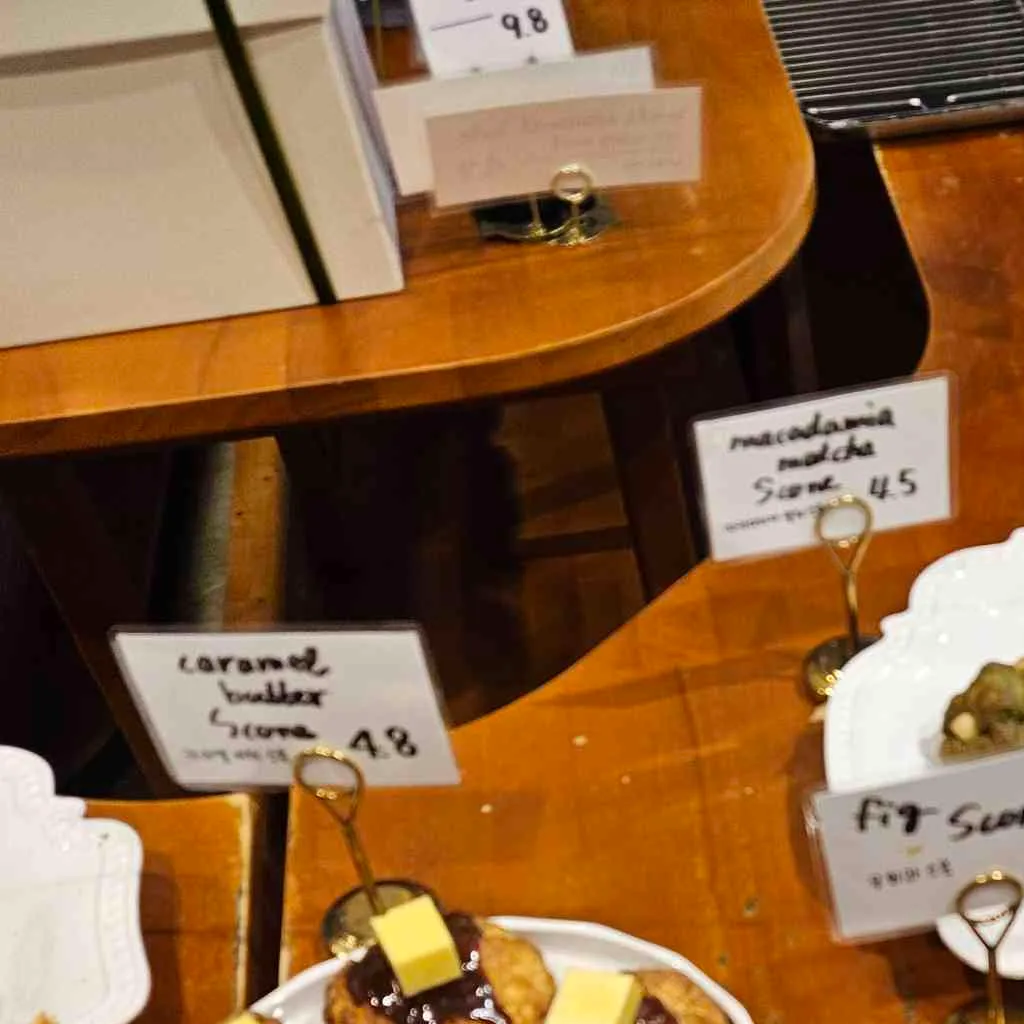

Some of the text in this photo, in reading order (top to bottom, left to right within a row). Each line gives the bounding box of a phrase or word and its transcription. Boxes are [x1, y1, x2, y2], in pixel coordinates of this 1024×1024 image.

[729, 407, 895, 451] macadamia
[777, 436, 875, 471] matcha
[754, 475, 840, 503] Scone
[178, 647, 330, 675] caramel
[218, 682, 325, 707] butter
